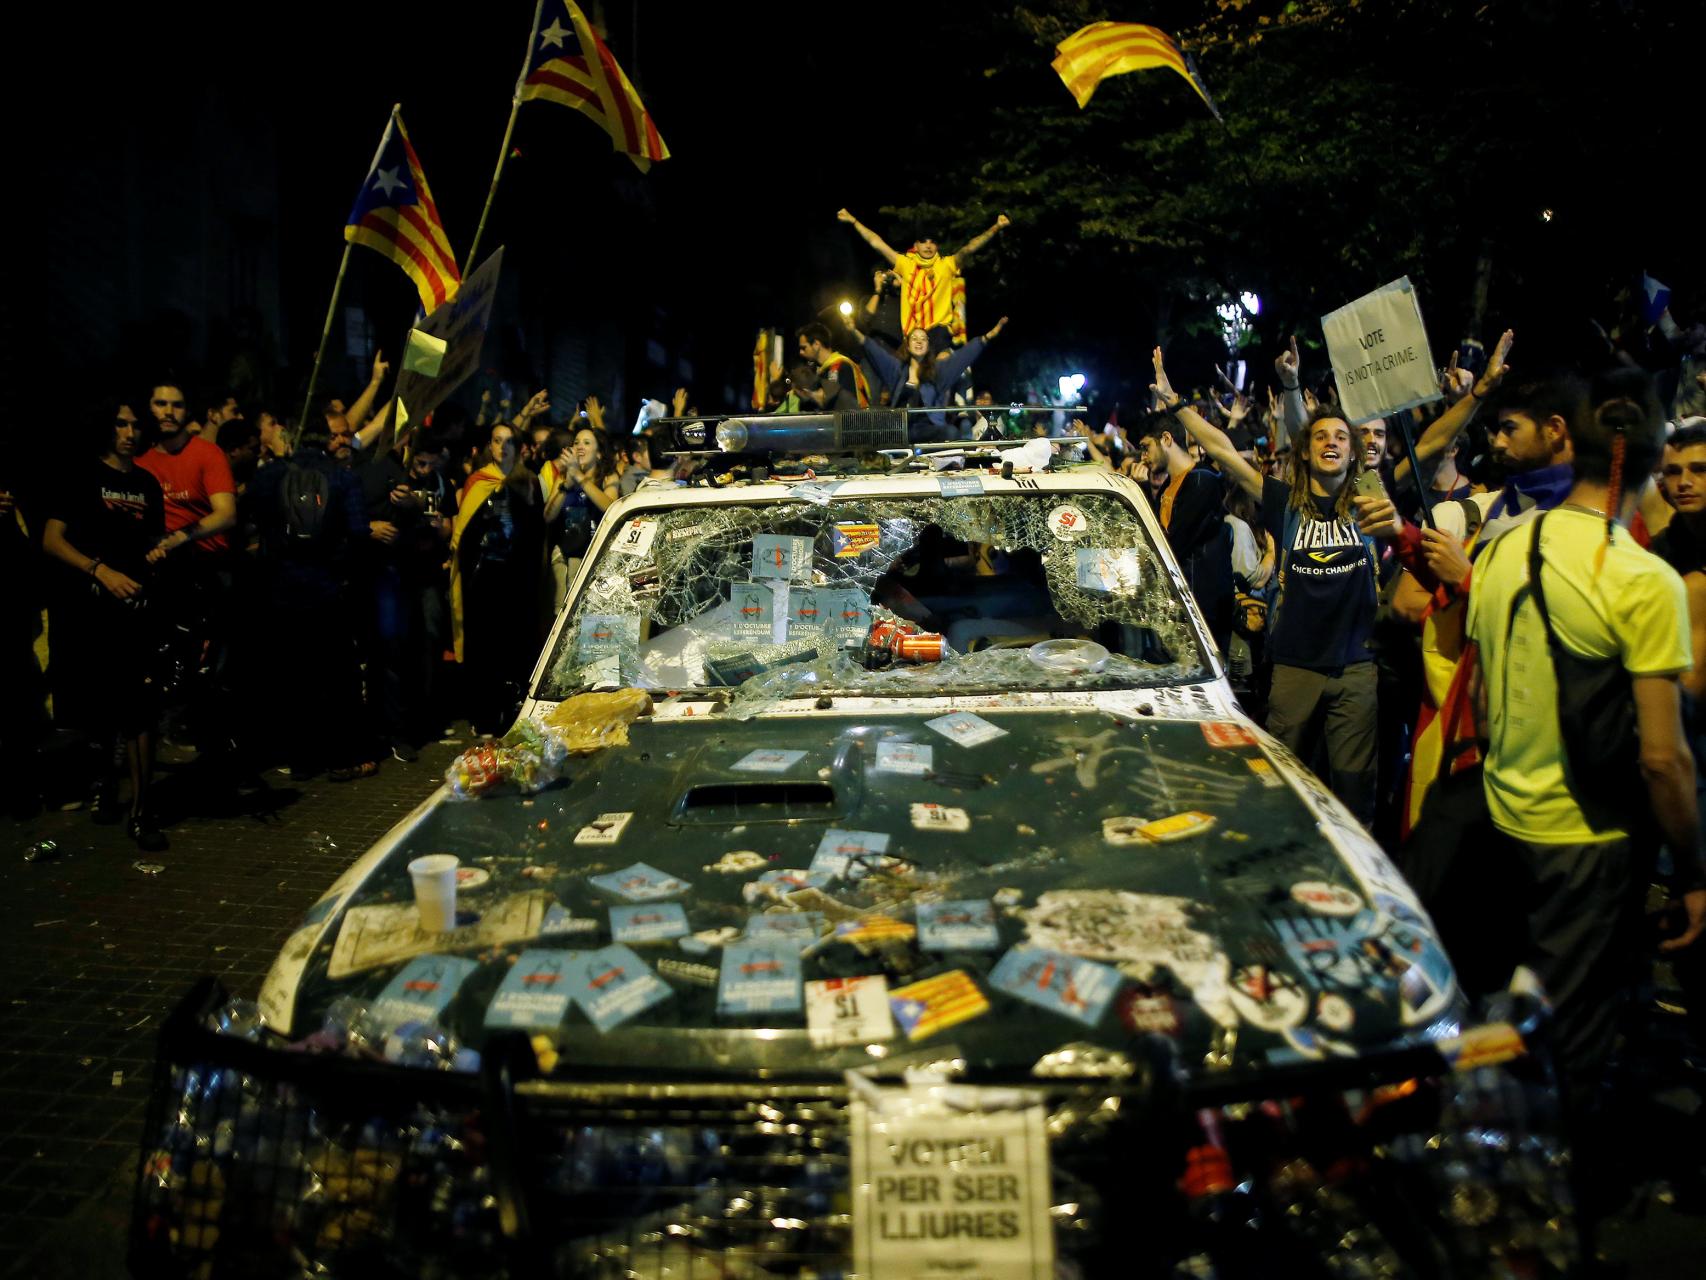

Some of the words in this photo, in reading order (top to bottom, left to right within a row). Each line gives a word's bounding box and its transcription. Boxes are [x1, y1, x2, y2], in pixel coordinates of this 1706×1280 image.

[1359, 328, 1385, 350] VOTE
[1345, 370, 1354, 386] IS
[1355, 362, 1374, 382] NOT
[1374, 360, 1382, 375] A
[1383, 346, 1418, 371] CRIME.
[1313, 567, 1324, 576] OF
[877, 1174, 942, 1203] PER
[953, 1174, 1020, 1202] SER
[879, 1210, 1020, 1239] LLIURES
